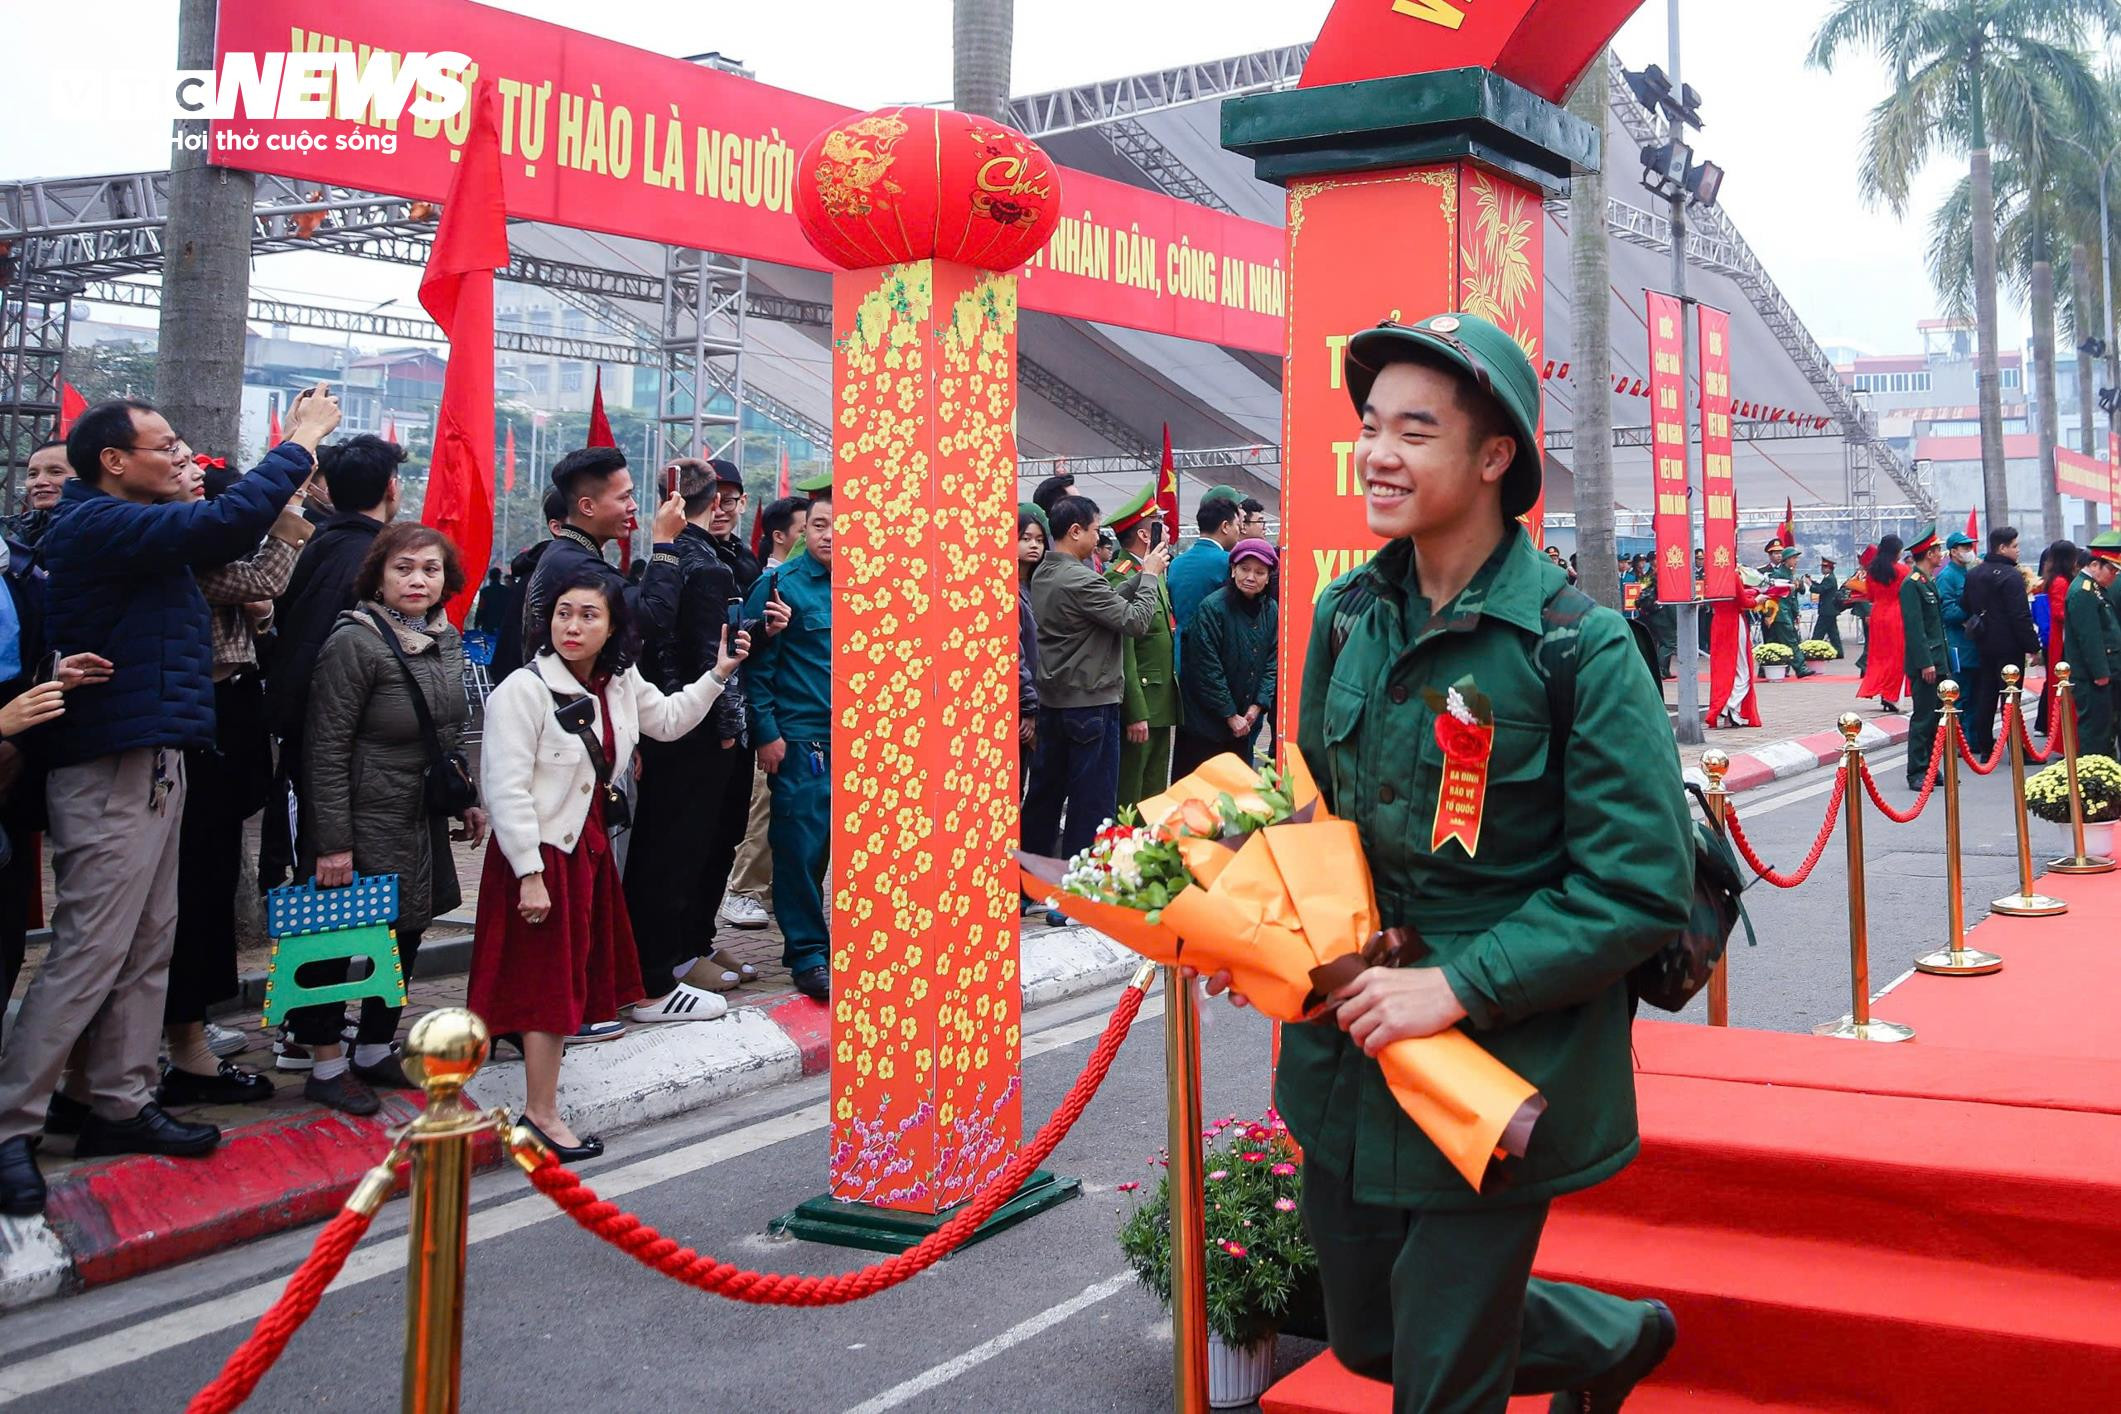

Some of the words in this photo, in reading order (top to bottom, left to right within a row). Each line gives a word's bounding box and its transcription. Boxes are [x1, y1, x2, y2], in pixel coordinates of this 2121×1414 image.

[498, 77, 551, 178] TỰ
[557, 83, 632, 180] HÀO
[643, 103, 685, 192] LÀ
[694, 127, 795, 215] NGƯỜI
[1050, 209, 1109, 281] NHÂN
[1115, 222, 1161, 299] DÂN,
[1167, 235, 1216, 304] CÔNG
[1221, 255, 1245, 310] AN
